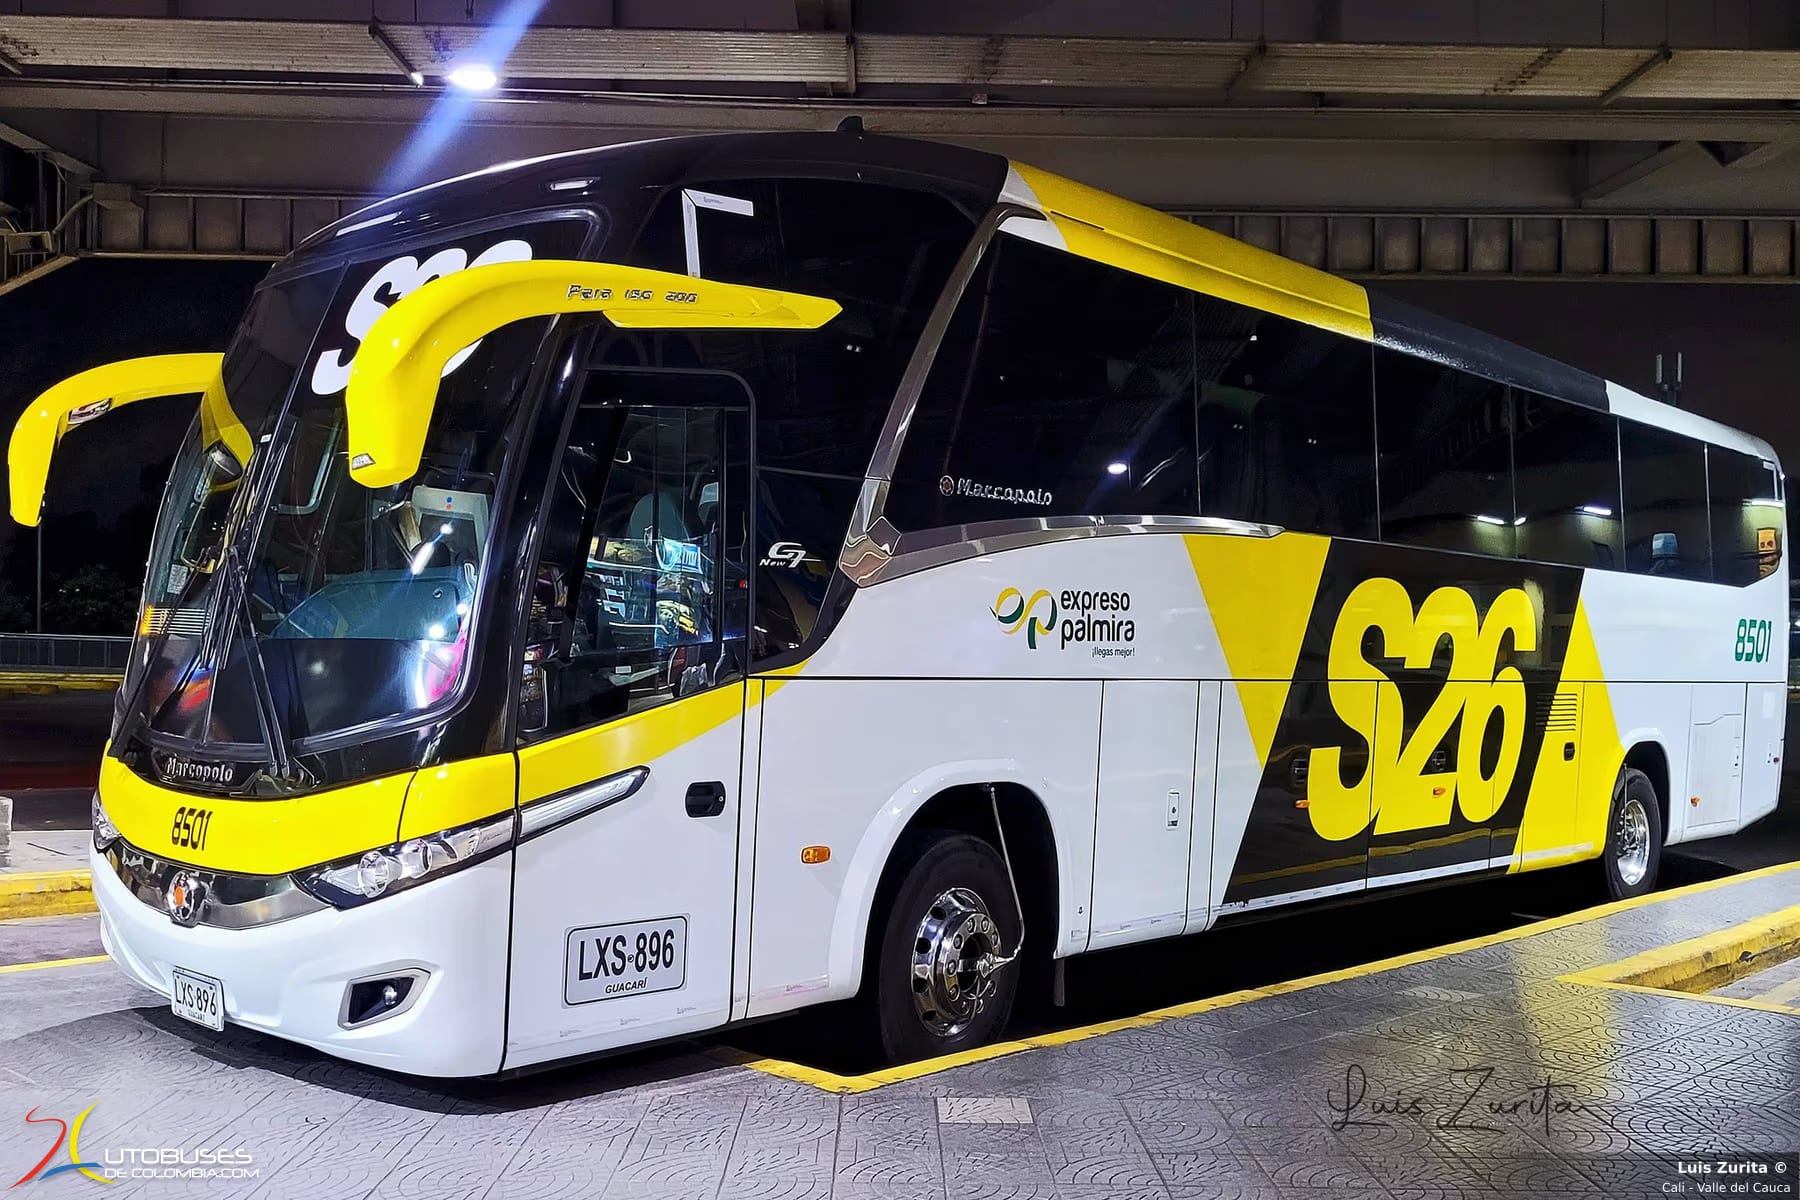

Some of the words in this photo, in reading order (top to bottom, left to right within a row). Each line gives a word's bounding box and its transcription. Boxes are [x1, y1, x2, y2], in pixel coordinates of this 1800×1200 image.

[957, 477, 1053, 506] Marcopolo
[1060, 589, 1131, 617] expreso
[1061, 613, 1136, 651] palmira
[1734, 618, 1773, 663] 8501
[1307, 576, 1537, 842] S26
[165, 757, 234, 782] Marcopolo
[171, 806, 214, 852] 8501
[604, 976, 648, 994] GUACARÍ
